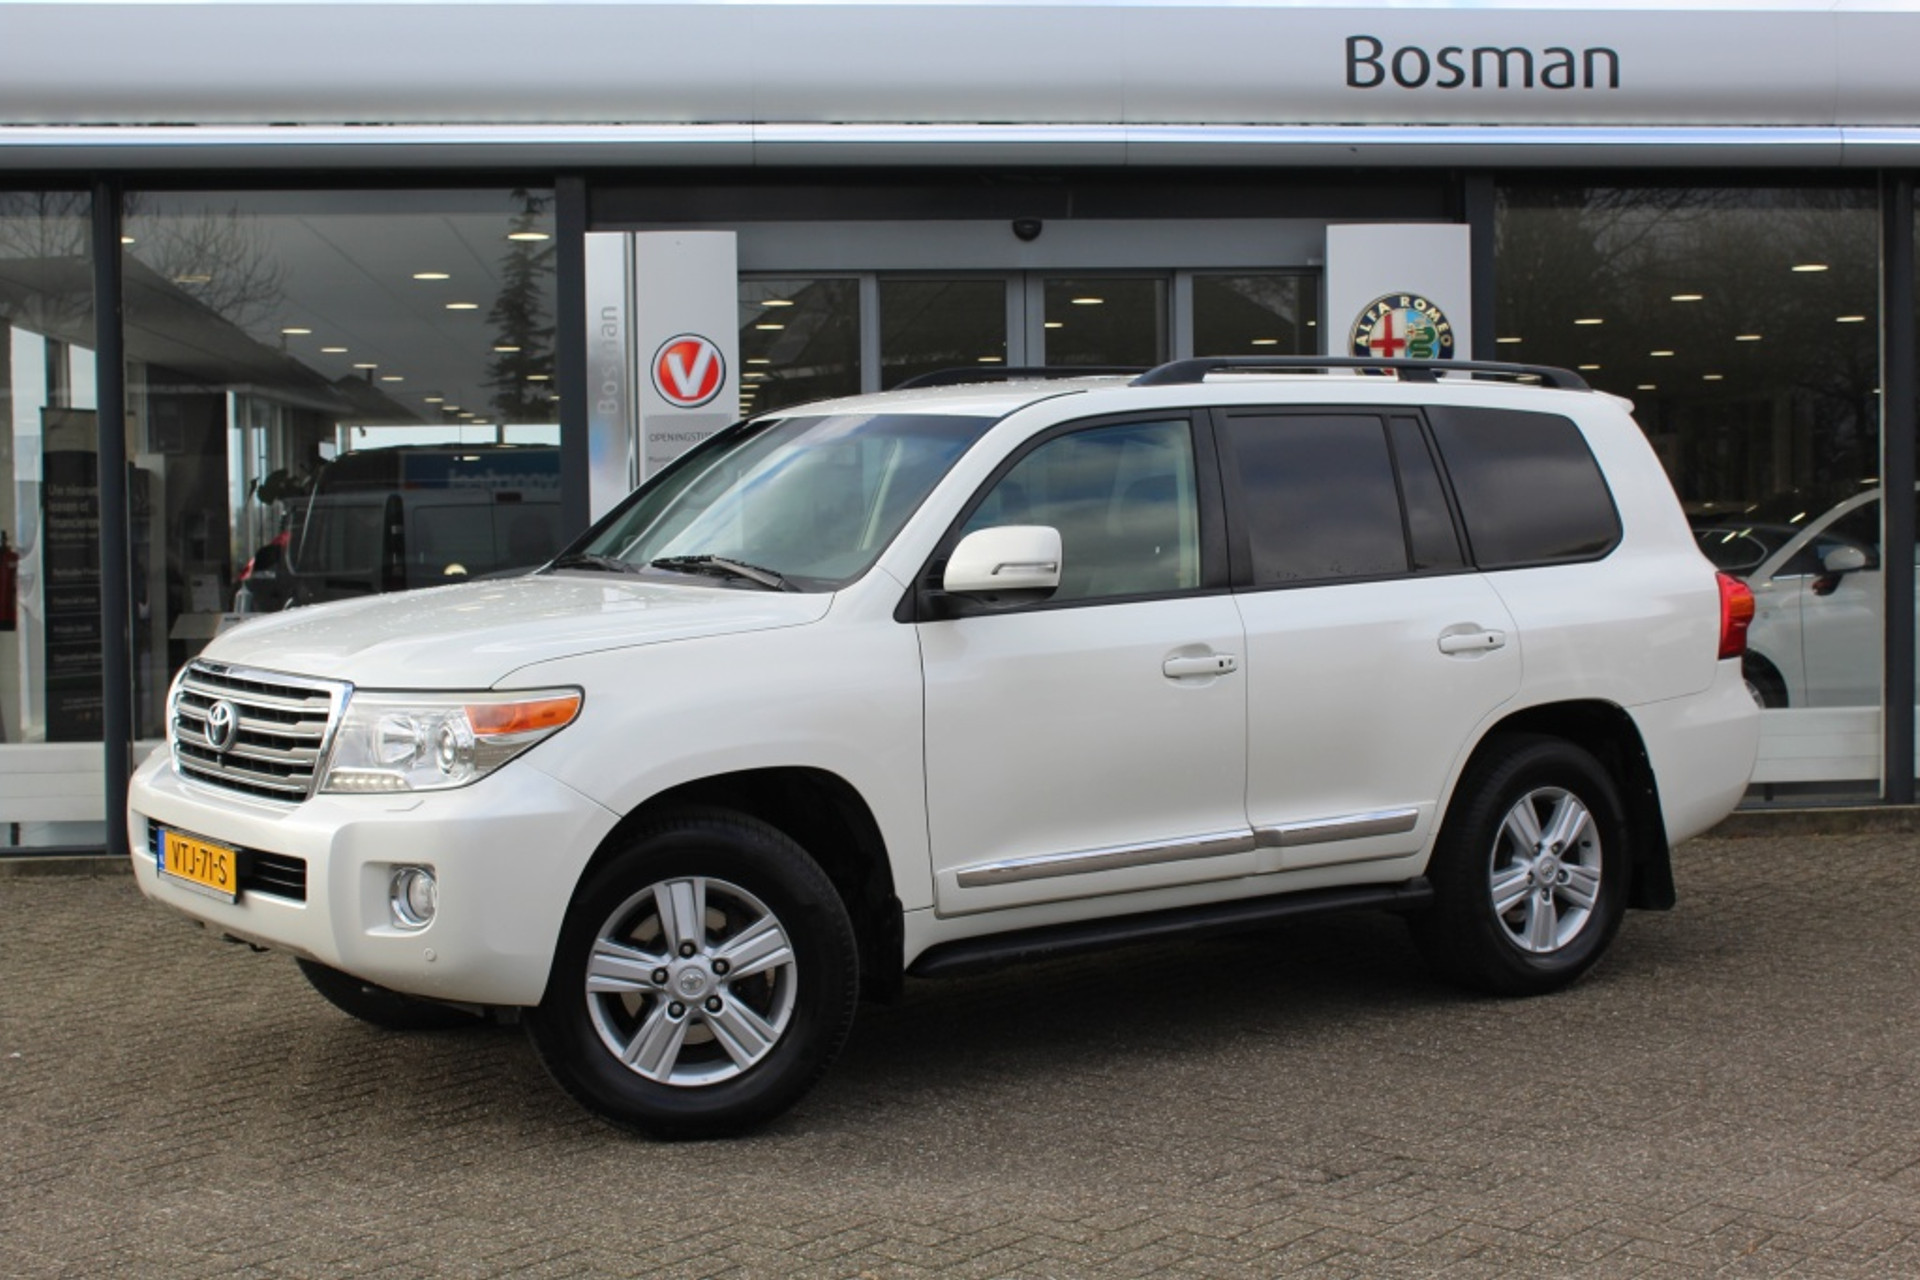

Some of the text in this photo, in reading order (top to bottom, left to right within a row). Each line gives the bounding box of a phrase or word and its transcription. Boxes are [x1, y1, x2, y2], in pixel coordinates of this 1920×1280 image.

[1345, 34, 1620, 89] Bosman
[1355, 295, 1452, 347] ALFA ROMEO
[171, 840, 228, 886] VTJ-71-S
